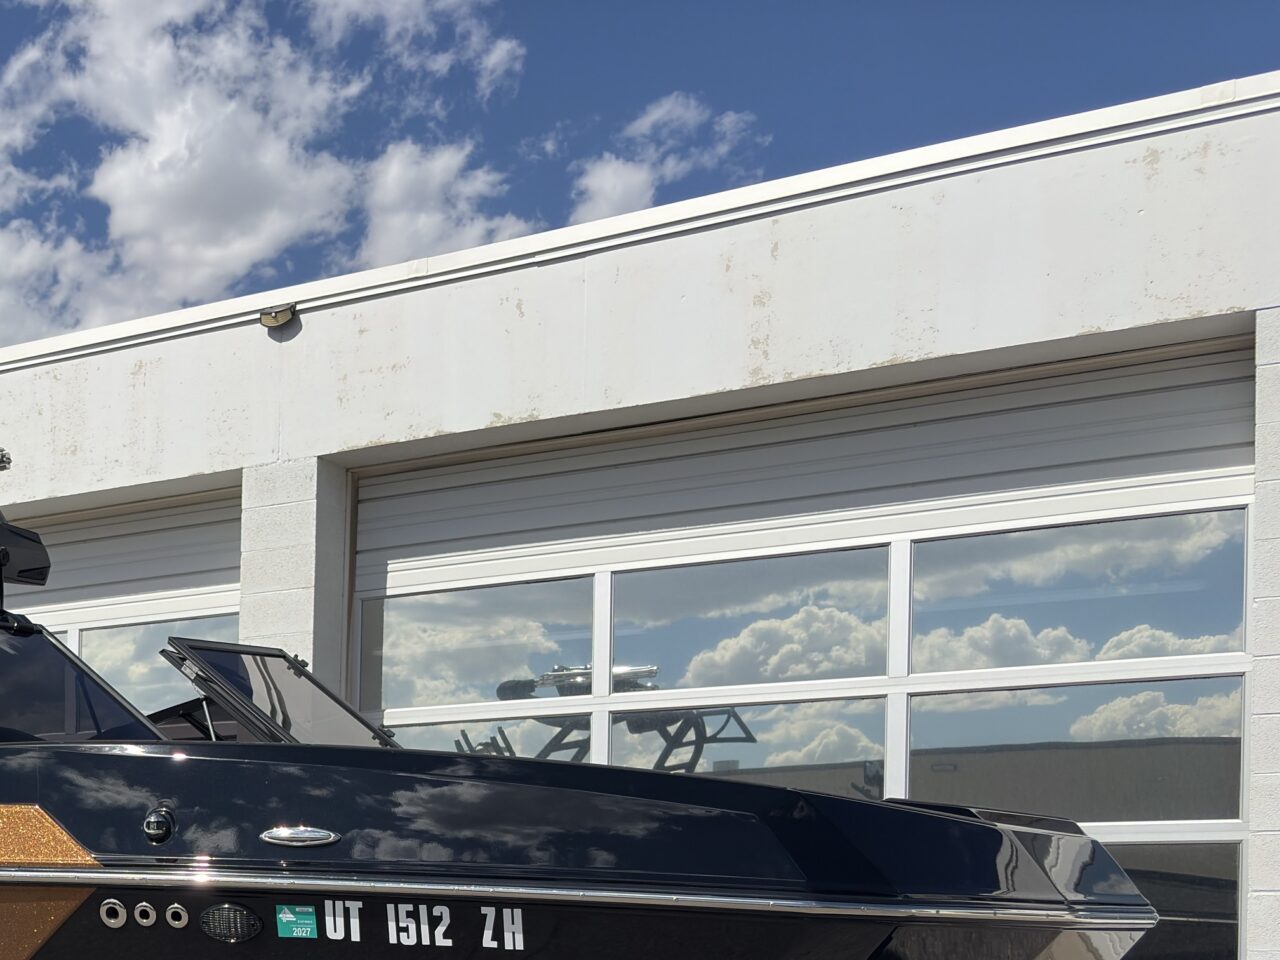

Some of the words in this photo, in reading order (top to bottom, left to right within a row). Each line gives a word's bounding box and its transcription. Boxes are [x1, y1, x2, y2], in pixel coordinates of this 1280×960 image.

[292, 927, 311, 937] 2027
[324, 900, 363, 942] UT
[386, 904, 453, 946] 1512
